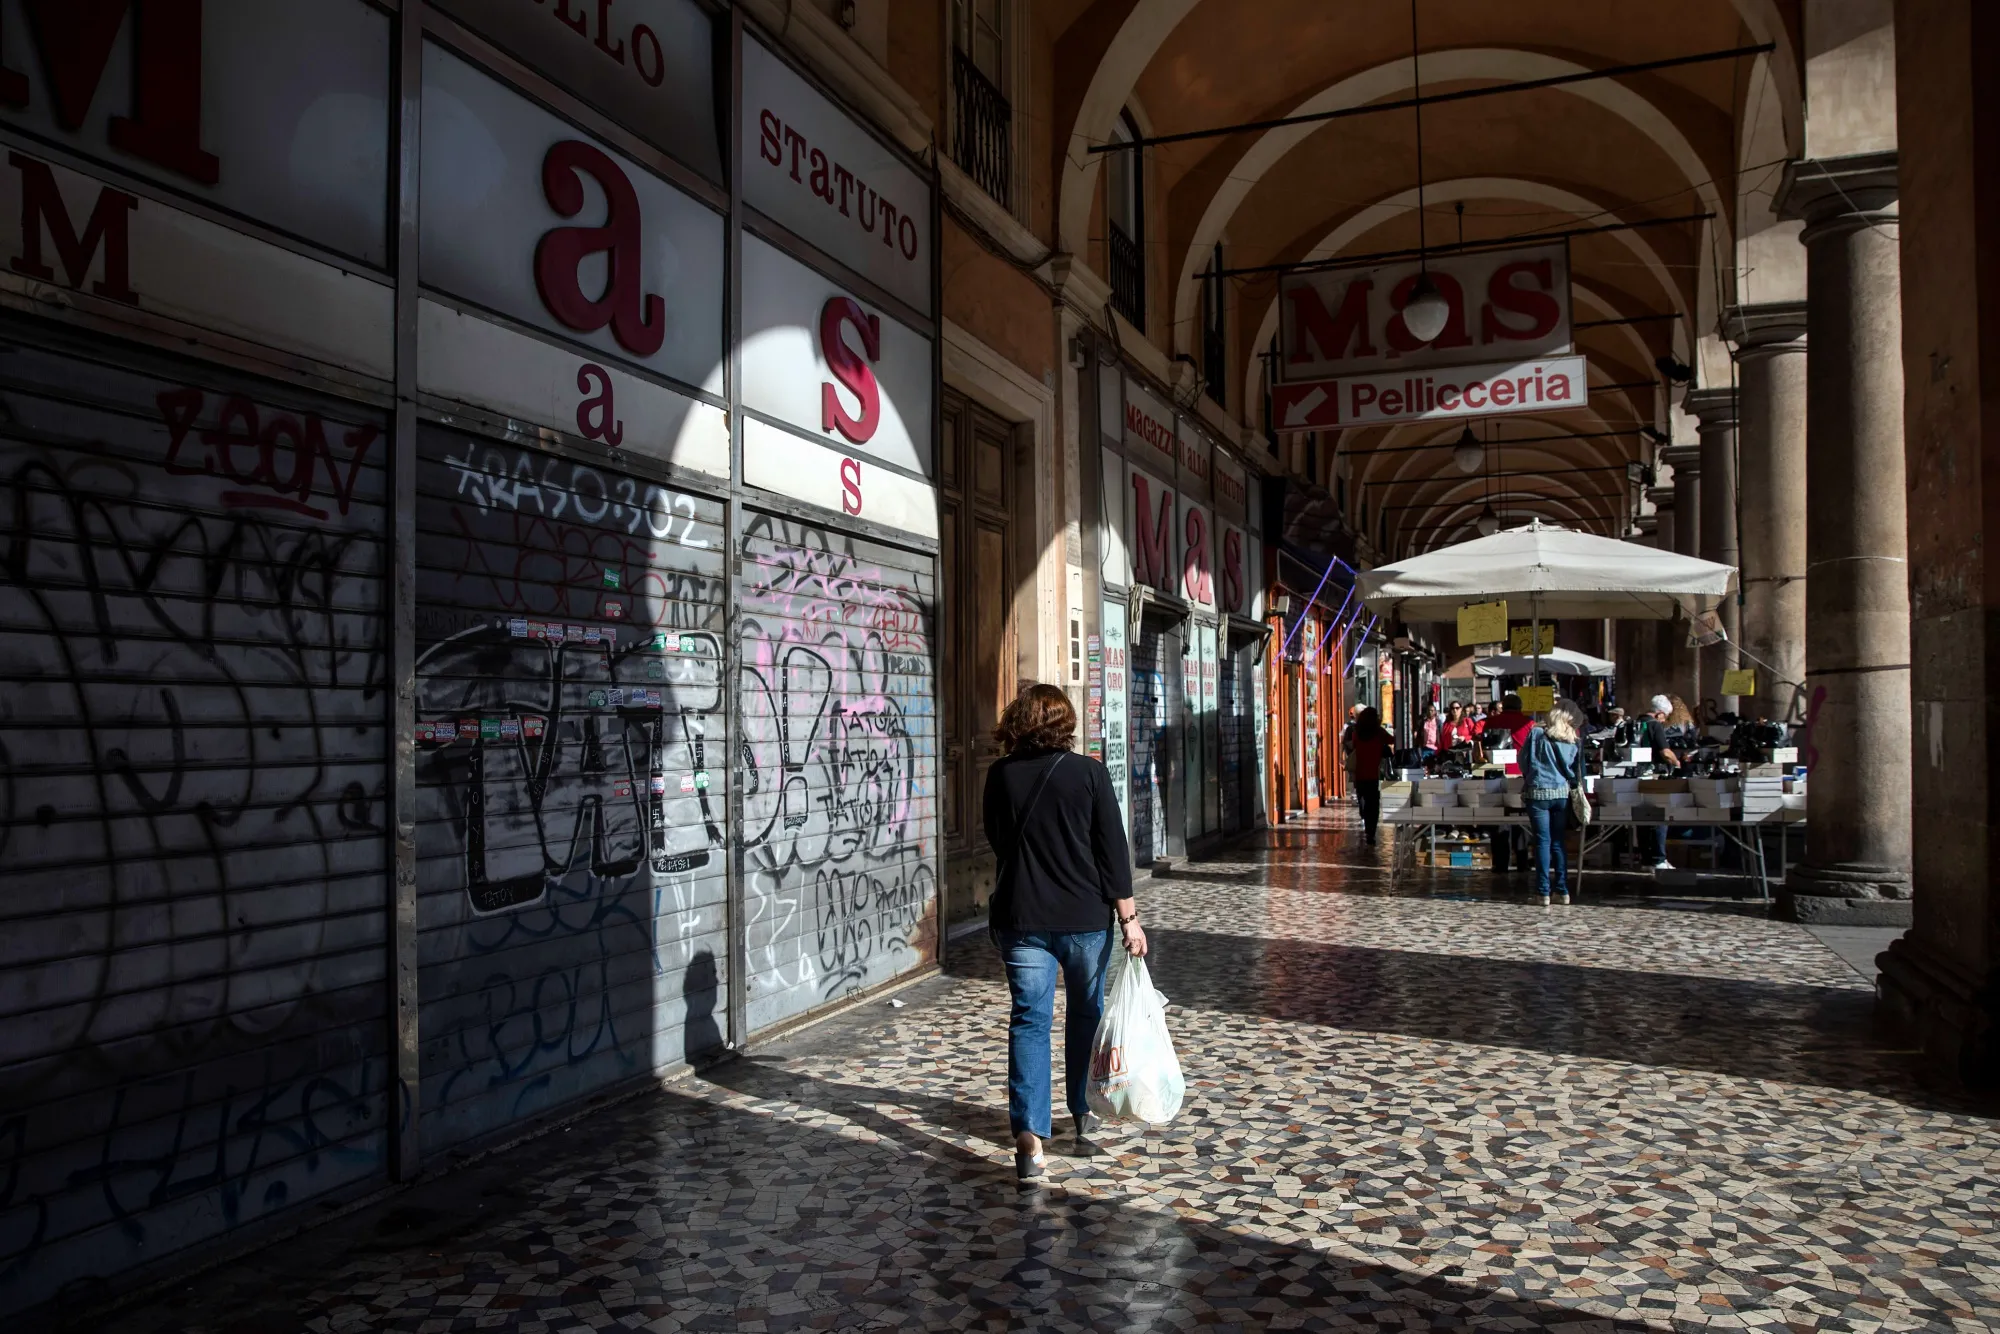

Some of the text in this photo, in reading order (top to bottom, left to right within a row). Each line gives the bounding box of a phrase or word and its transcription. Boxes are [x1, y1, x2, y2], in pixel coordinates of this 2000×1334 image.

[1351, 367, 1571, 418] Pellicceria
[1104, 647, 1124, 668] MAS
[1107, 672, 1123, 691] ORO
